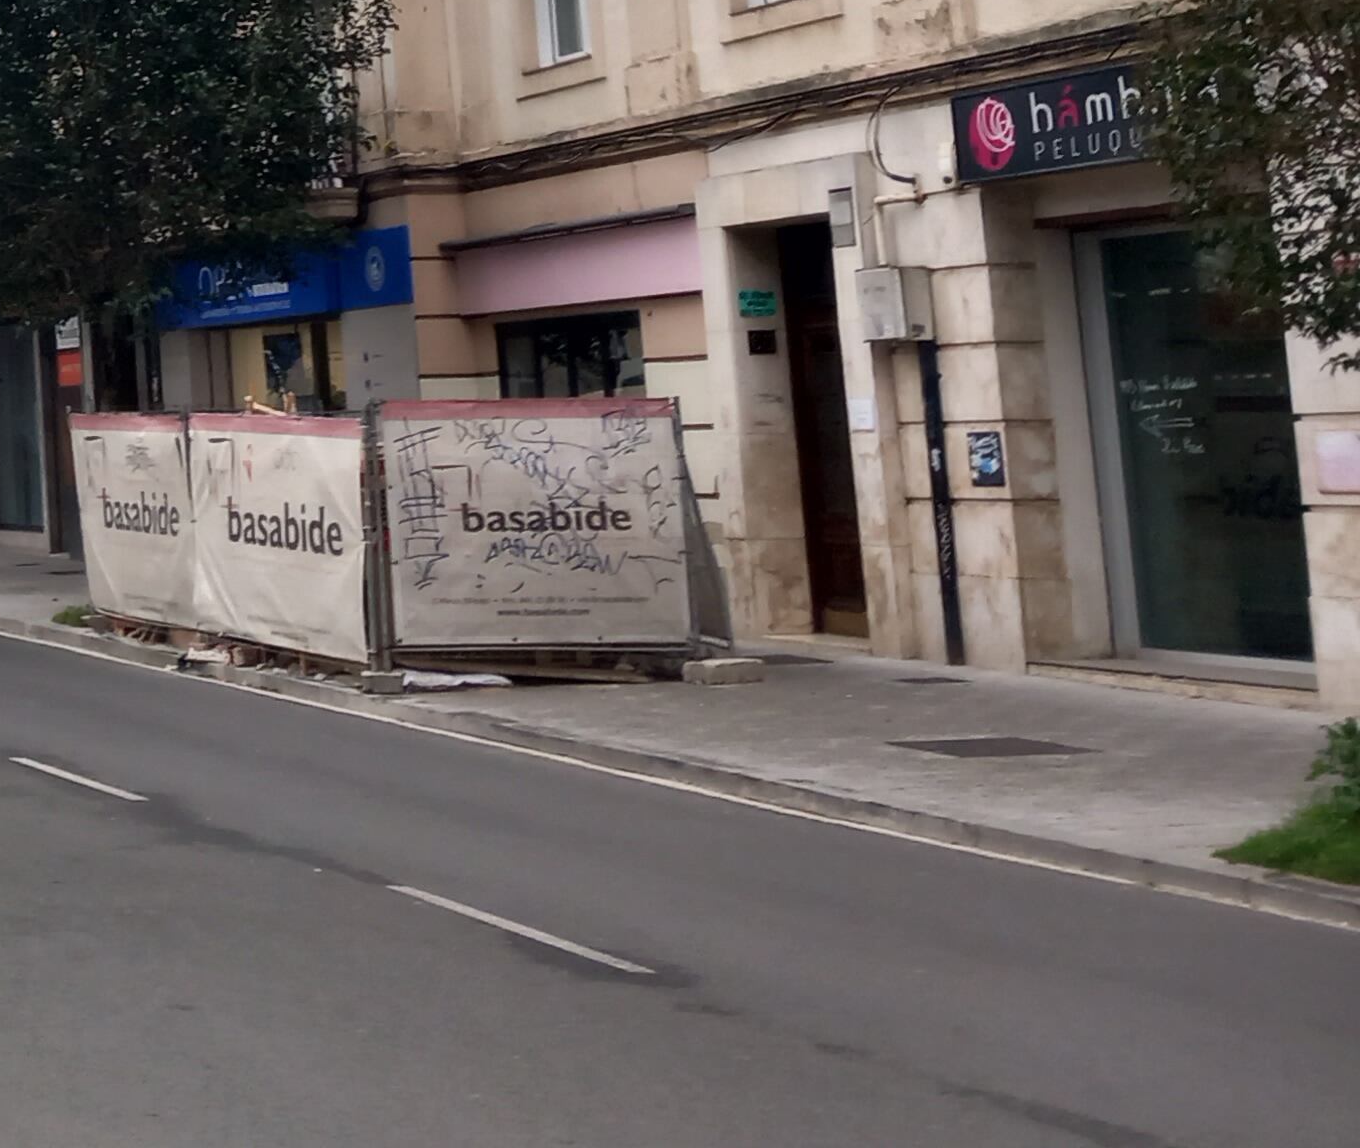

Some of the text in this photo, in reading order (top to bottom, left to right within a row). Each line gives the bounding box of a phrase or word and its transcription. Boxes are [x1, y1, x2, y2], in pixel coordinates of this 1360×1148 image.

[1029, 75, 1220, 134] hámb
[1033, 128, 1146, 162] PELUQU
[100, 489, 181, 537] basabide
[226, 497, 344, 556] basabide
[461, 501, 633, 533] basabide
